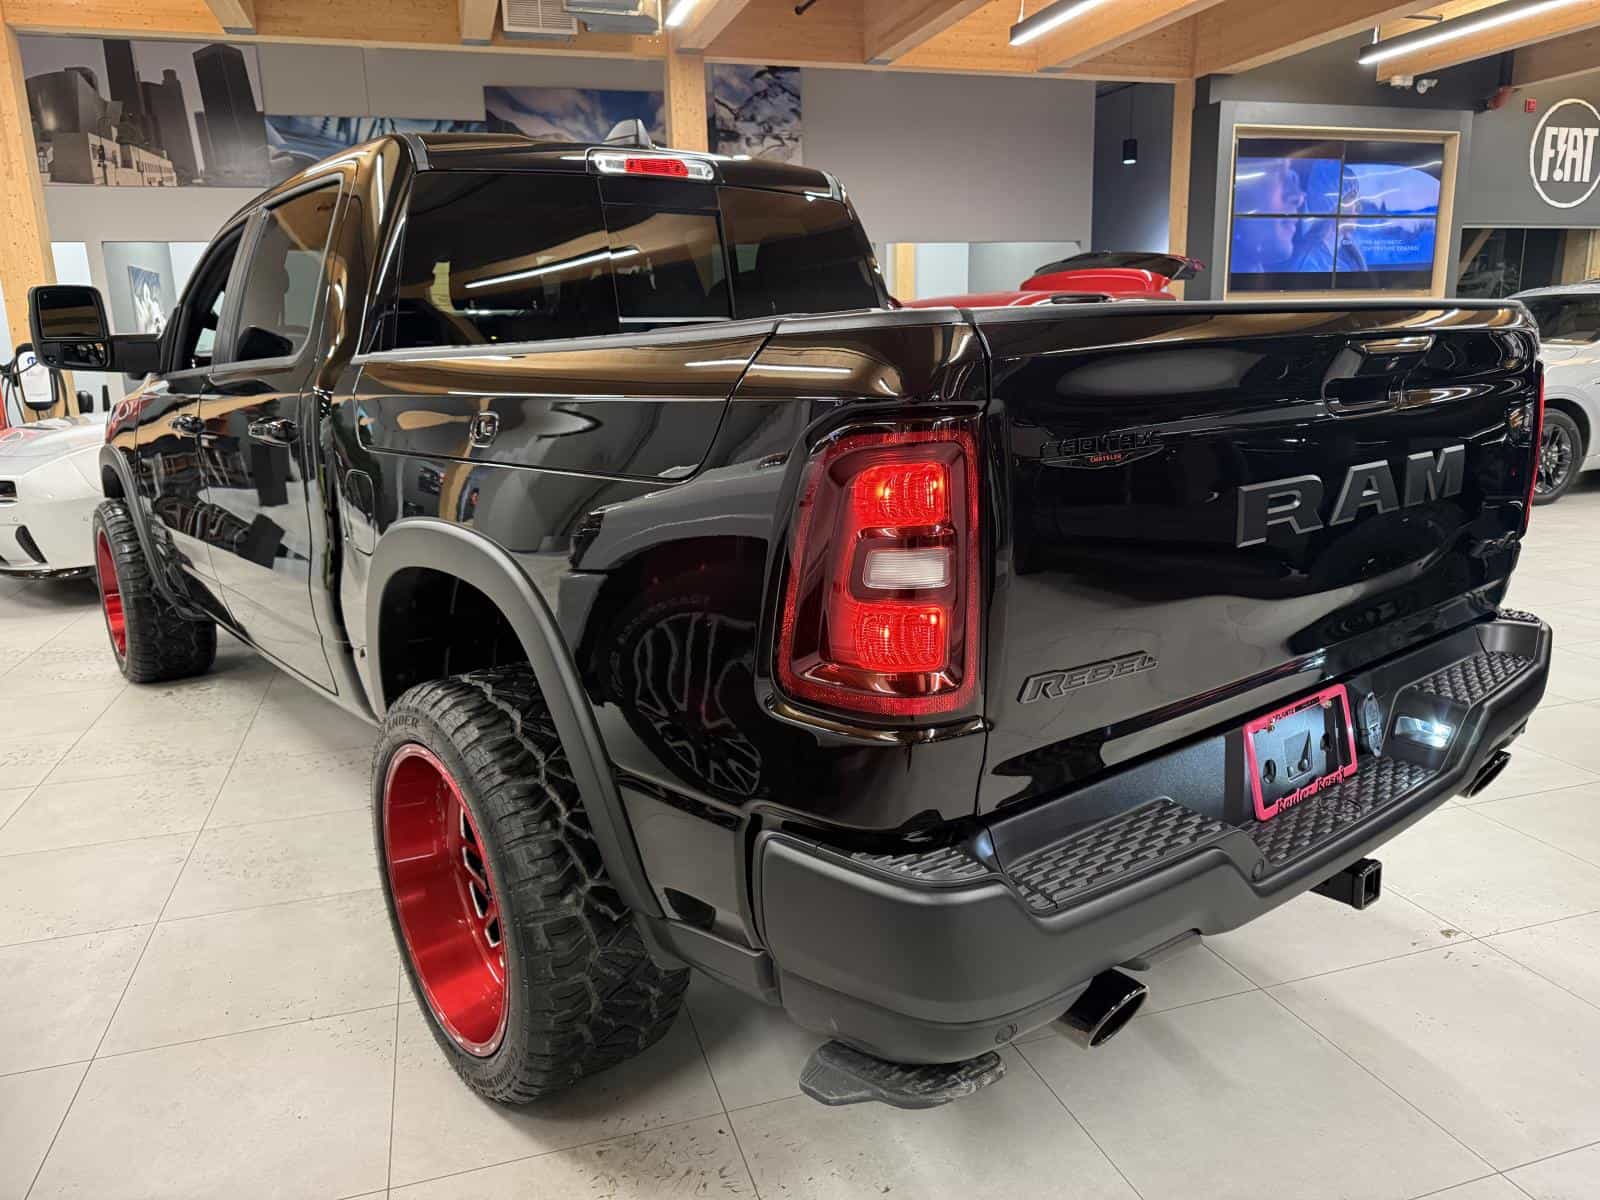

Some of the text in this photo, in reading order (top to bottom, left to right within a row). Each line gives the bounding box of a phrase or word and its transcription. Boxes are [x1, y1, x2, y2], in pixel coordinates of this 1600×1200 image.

[1539, 127, 1599, 183] FIAT
[1236, 444, 1466, 548] RAM
[1017, 651, 1159, 704] REBEL
